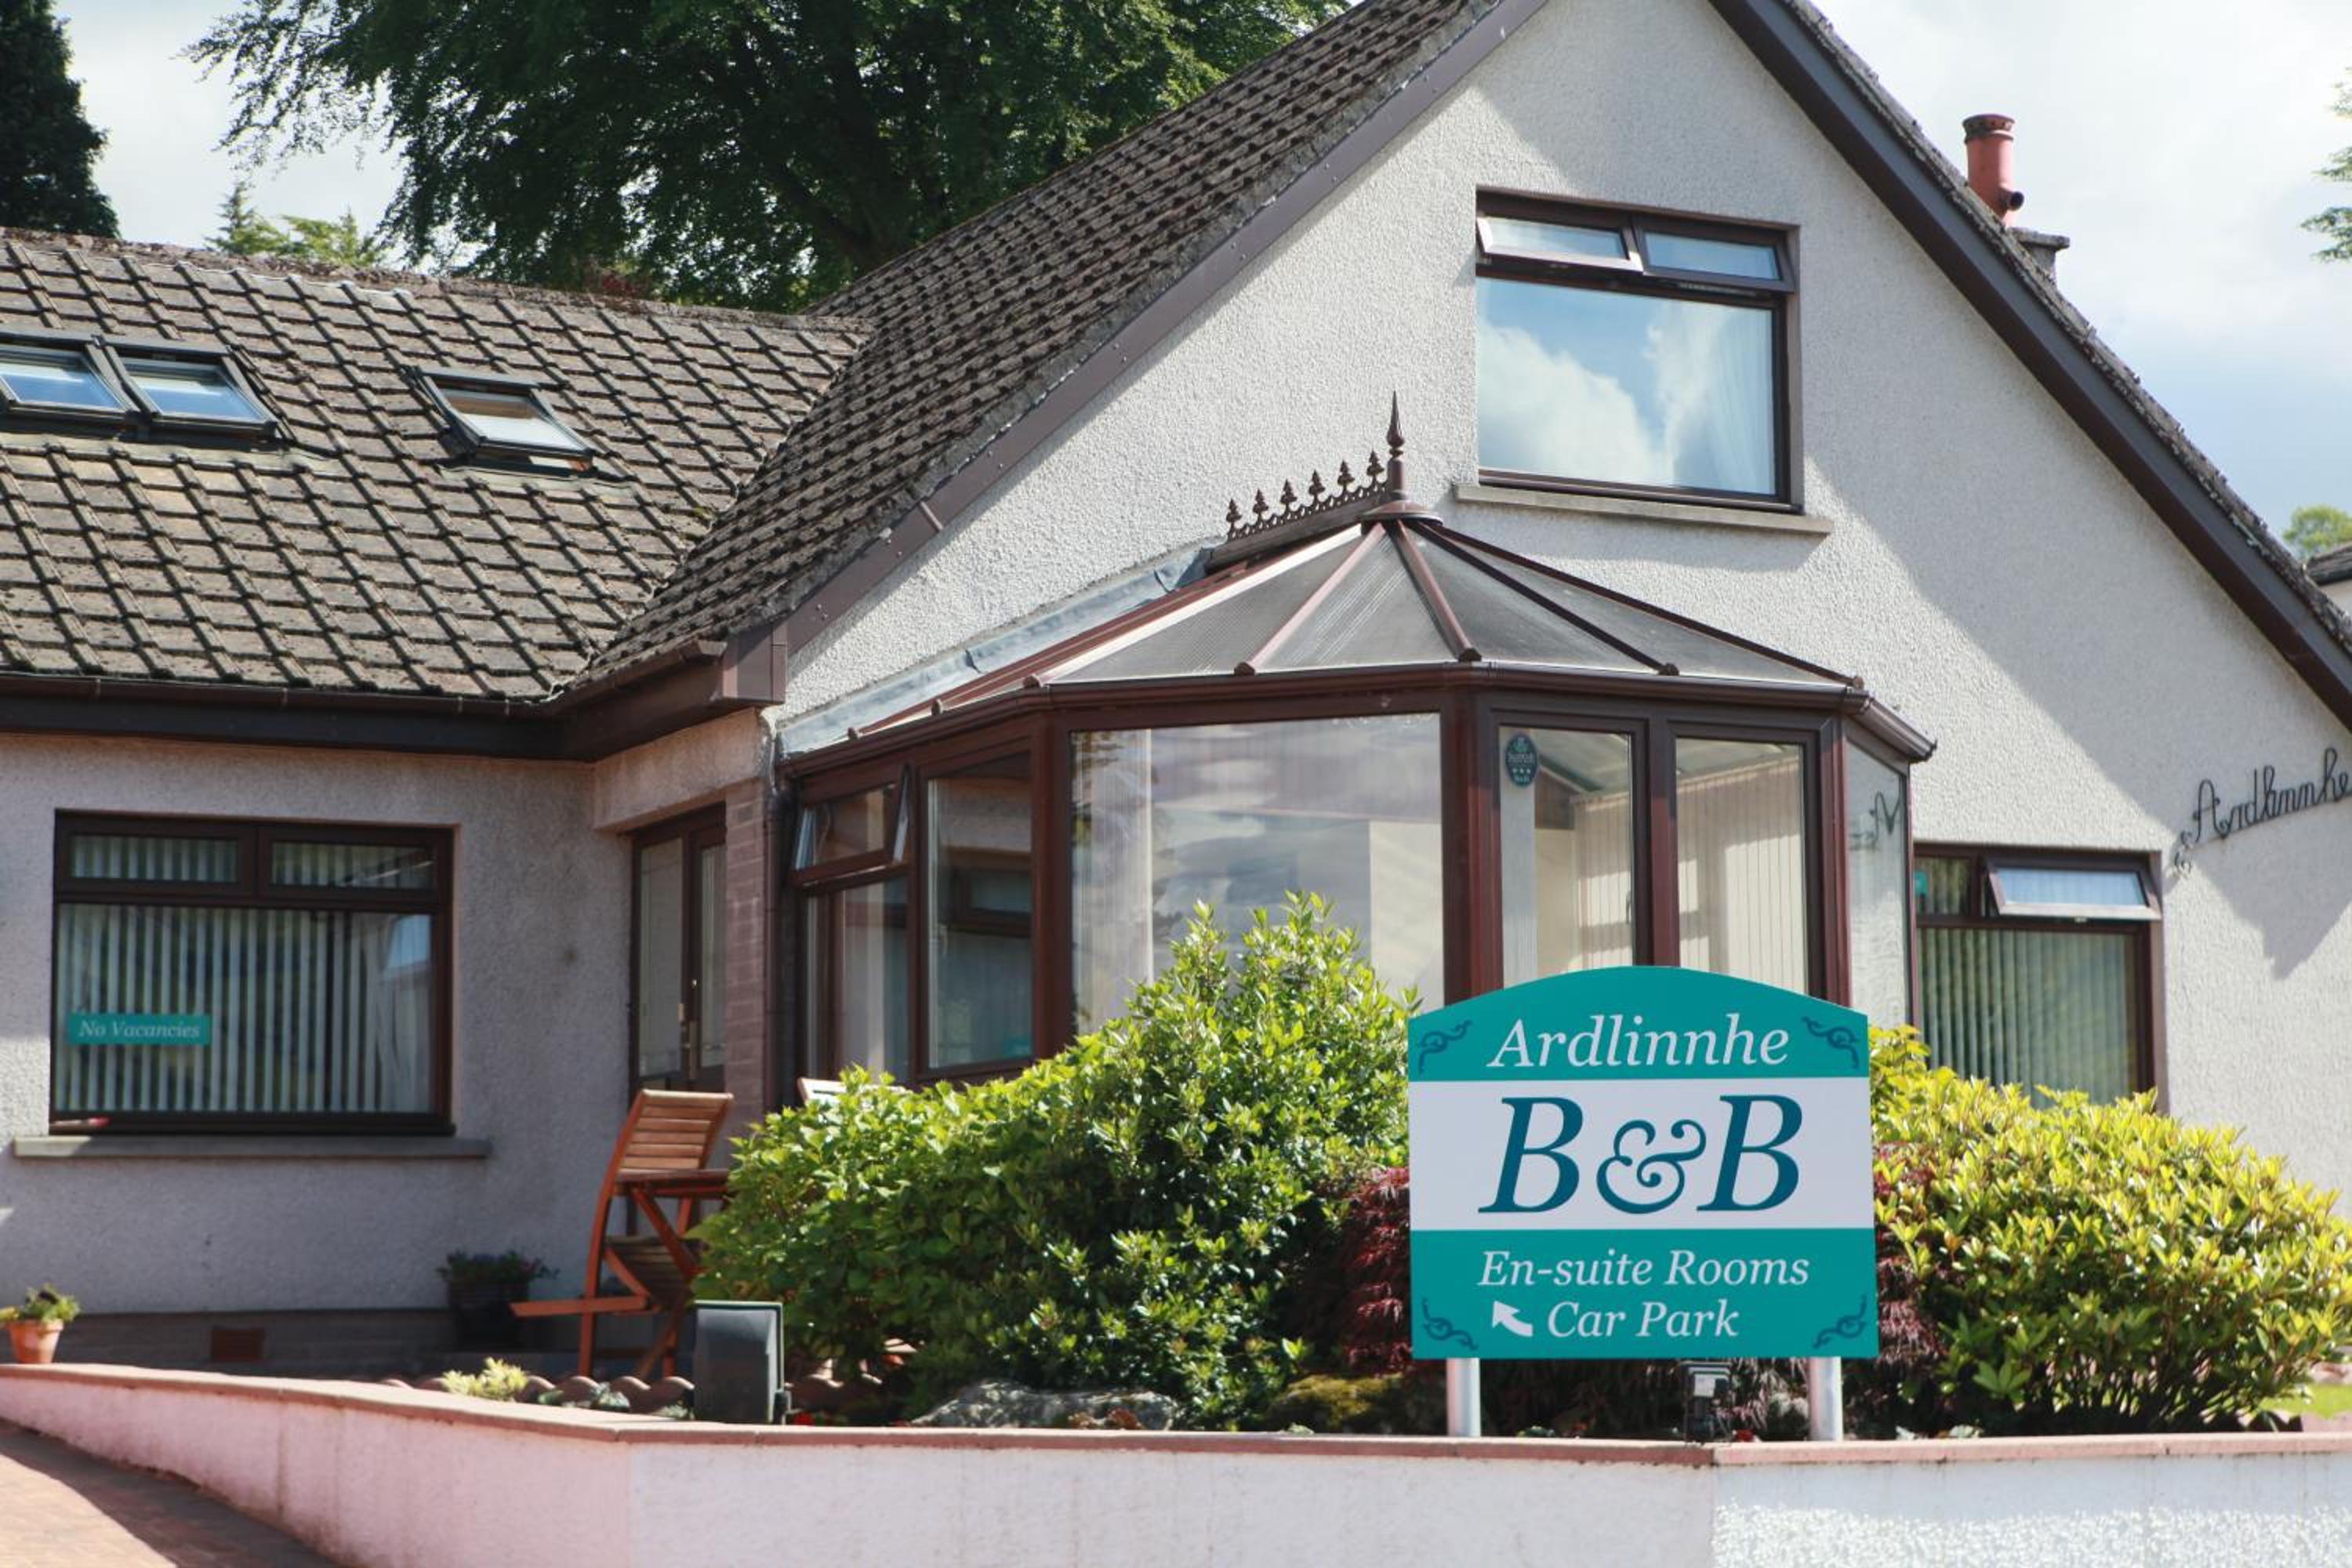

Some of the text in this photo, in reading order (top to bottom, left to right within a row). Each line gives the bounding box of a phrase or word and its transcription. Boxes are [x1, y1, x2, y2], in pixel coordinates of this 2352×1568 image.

[79, 1020, 201, 1038] No Vacancies
[1486, 1012, 1789, 1067] Ardlinnhe
[1479, 1094, 1802, 1214] B&B
[1478, 1248, 1809, 1286] En-suite Rooms
[1548, 1299, 1739, 1338] Car Park
